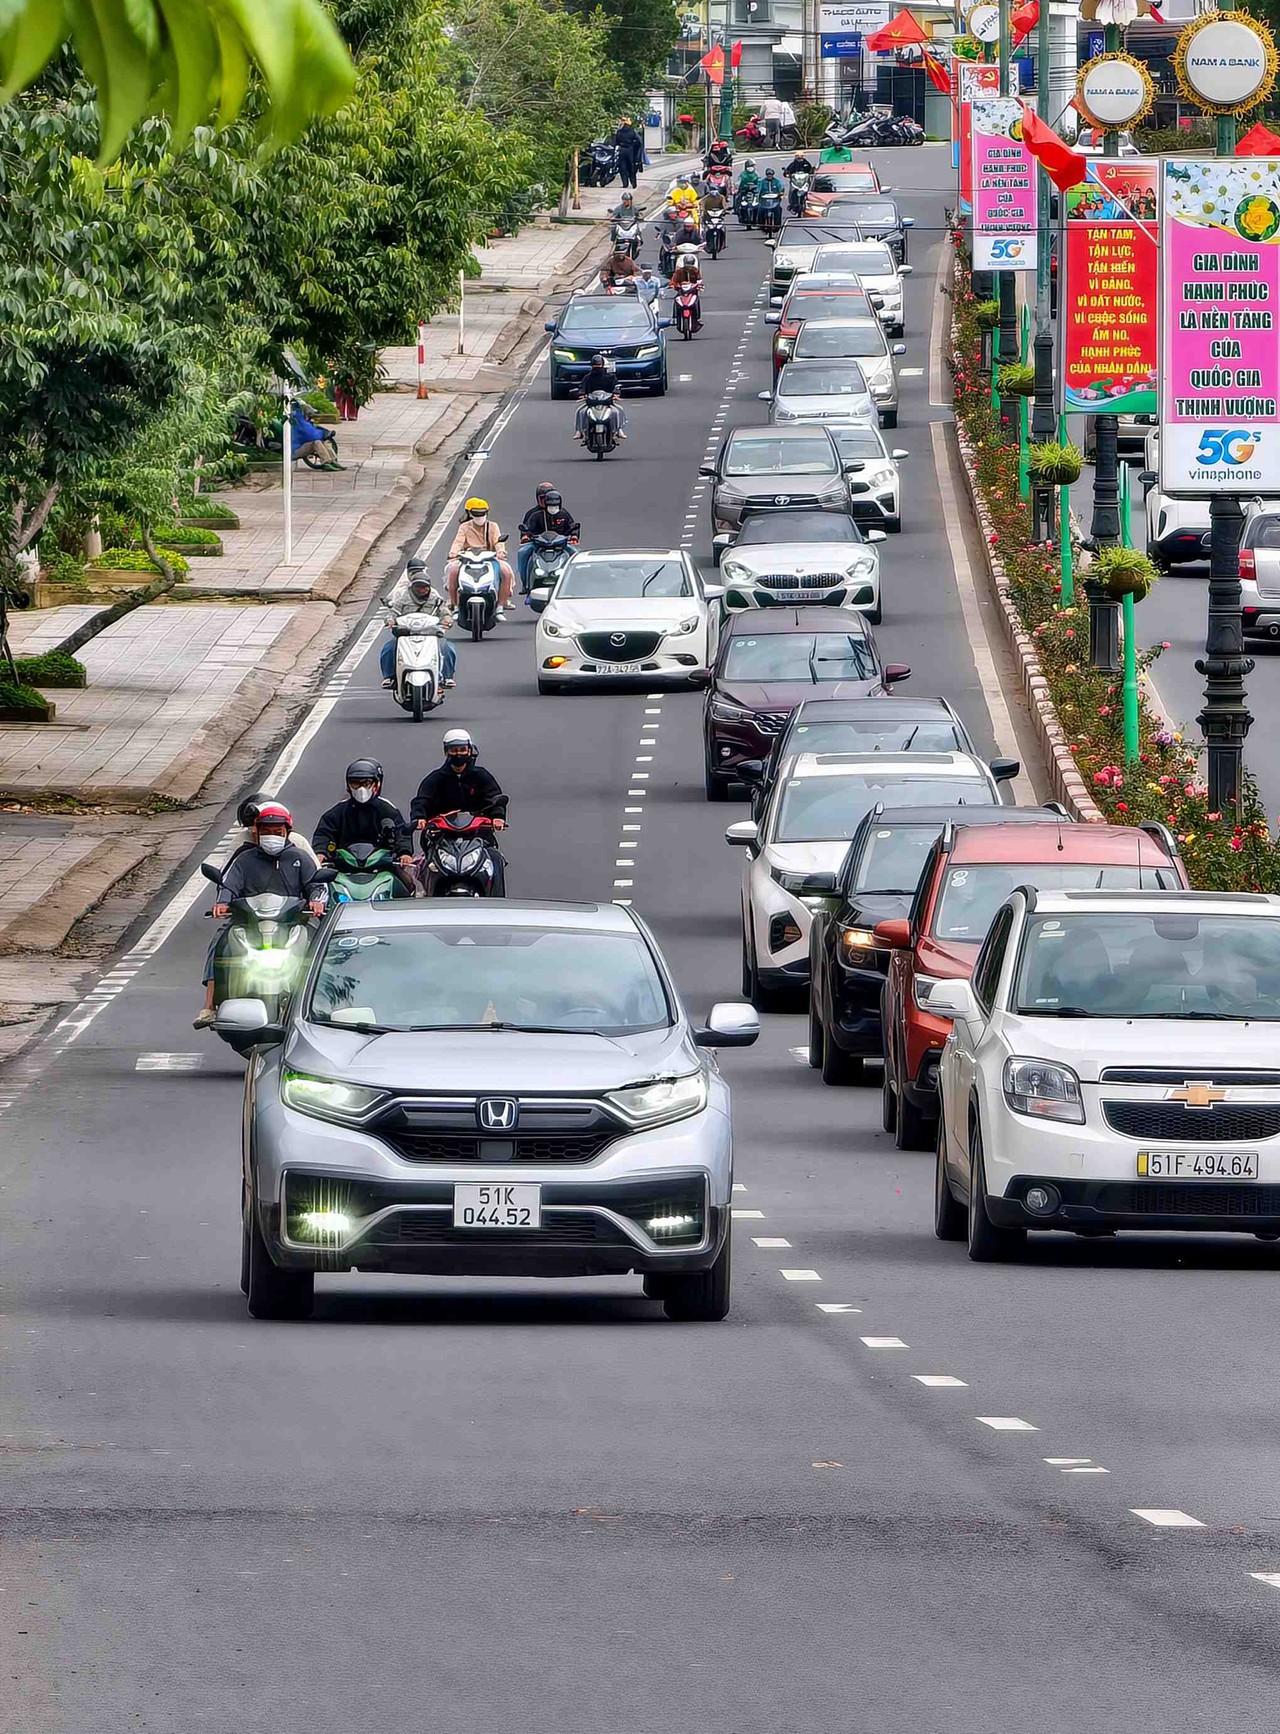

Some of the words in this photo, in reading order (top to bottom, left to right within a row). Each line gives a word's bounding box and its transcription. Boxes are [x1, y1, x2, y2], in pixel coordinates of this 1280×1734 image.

[1191, 58, 1218, 66] NAM
[1193, 253, 1219, 272] GIA
[1183, 283, 1224, 303] HẠNH
[1180, 309, 1198, 329] LÀ
[1201, 306, 1229, 329] NỀN
[1211, 337, 1242, 358] CỦA
[1190, 363, 1232, 389] QUỐC
[1236, 369, 1261, 387] GIA
[1176, 399, 1221, 419] THỊNH
[1224, 396, 1276, 419] VƯỢNG
[1188, 468, 1262, 483] vinaphone
[1151, 1154, 1254, 1176] 51F-494.64
[479, 1187, 515, 1205] 51K
[463, 1207, 531, 1225] 044.52
